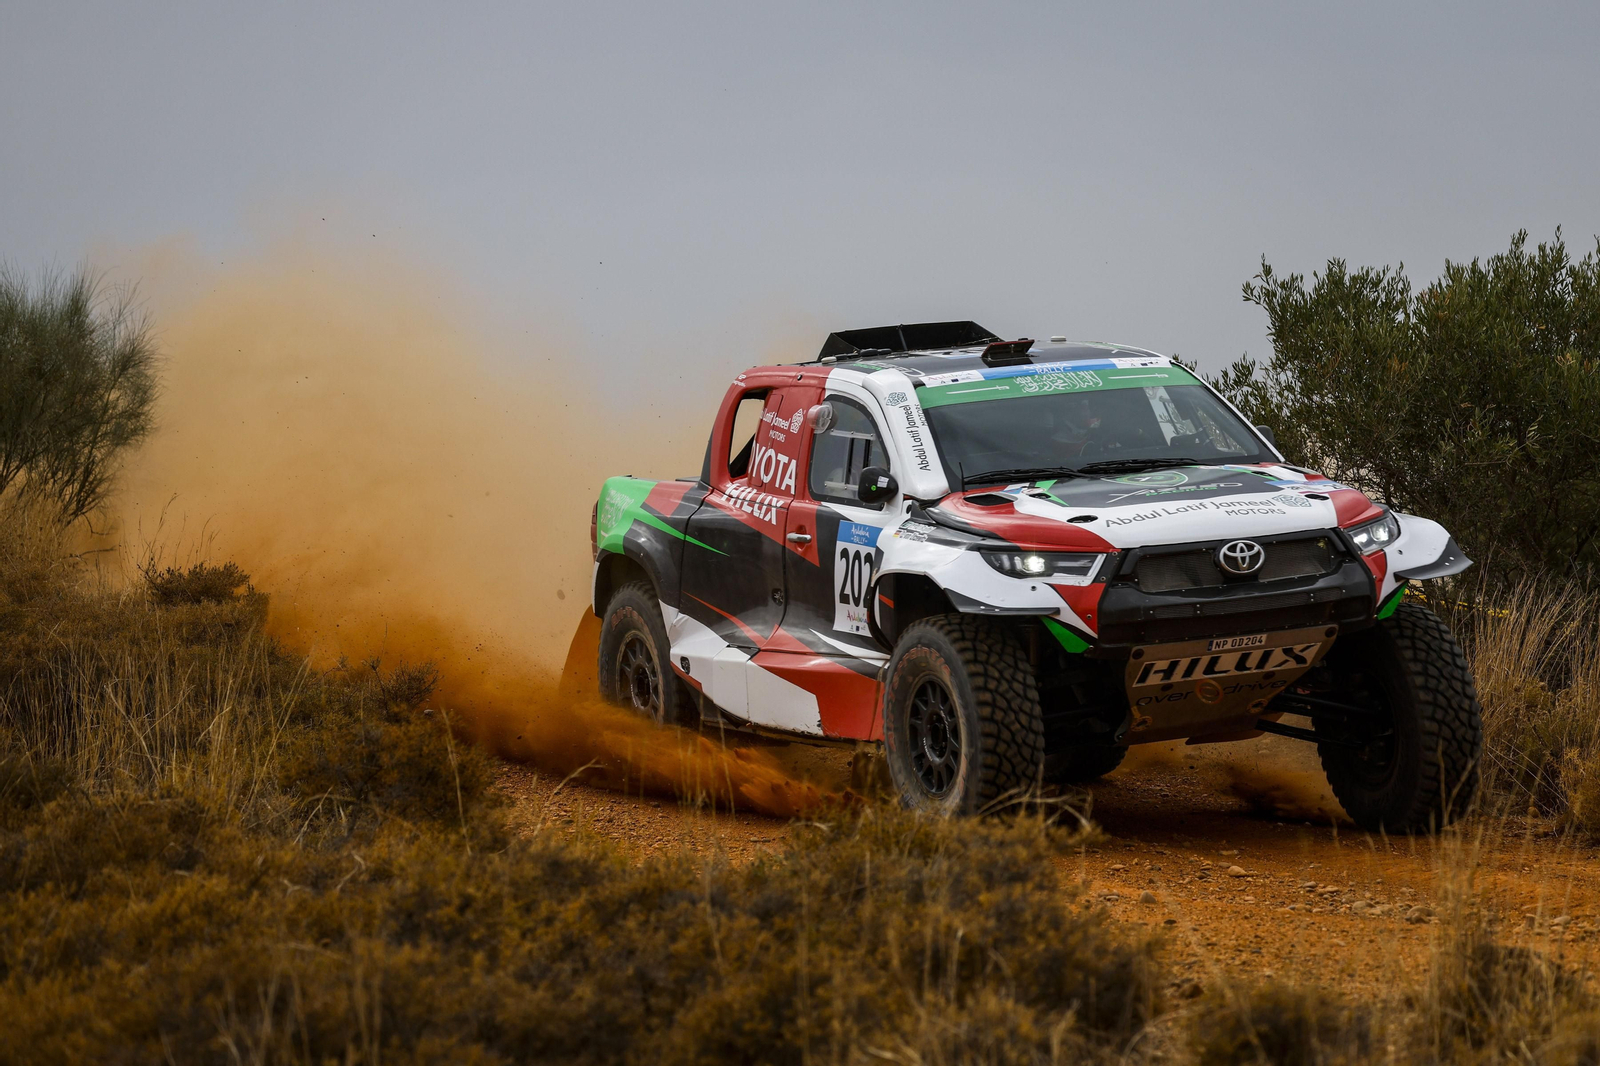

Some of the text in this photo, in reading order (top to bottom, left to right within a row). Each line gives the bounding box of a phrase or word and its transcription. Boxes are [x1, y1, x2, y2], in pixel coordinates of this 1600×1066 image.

[1035, 366, 1064, 374] RALLY
[915, 404, 928, 426] MOTORS
[769, 430, 786, 443] MOTORS
[899, 404, 931, 472] Abdul Latif Jameel
[721, 483, 785, 525] HILUX
[1106, 499, 1276, 528] Abdul Latif Jameel
[1225, 508, 1286, 516] MOTORS
[839, 548, 874, 608] 202
[1214, 641, 1228, 649] NP
[1135, 644, 1316, 684] HILUX
[1136, 680, 1287, 706] over drive
